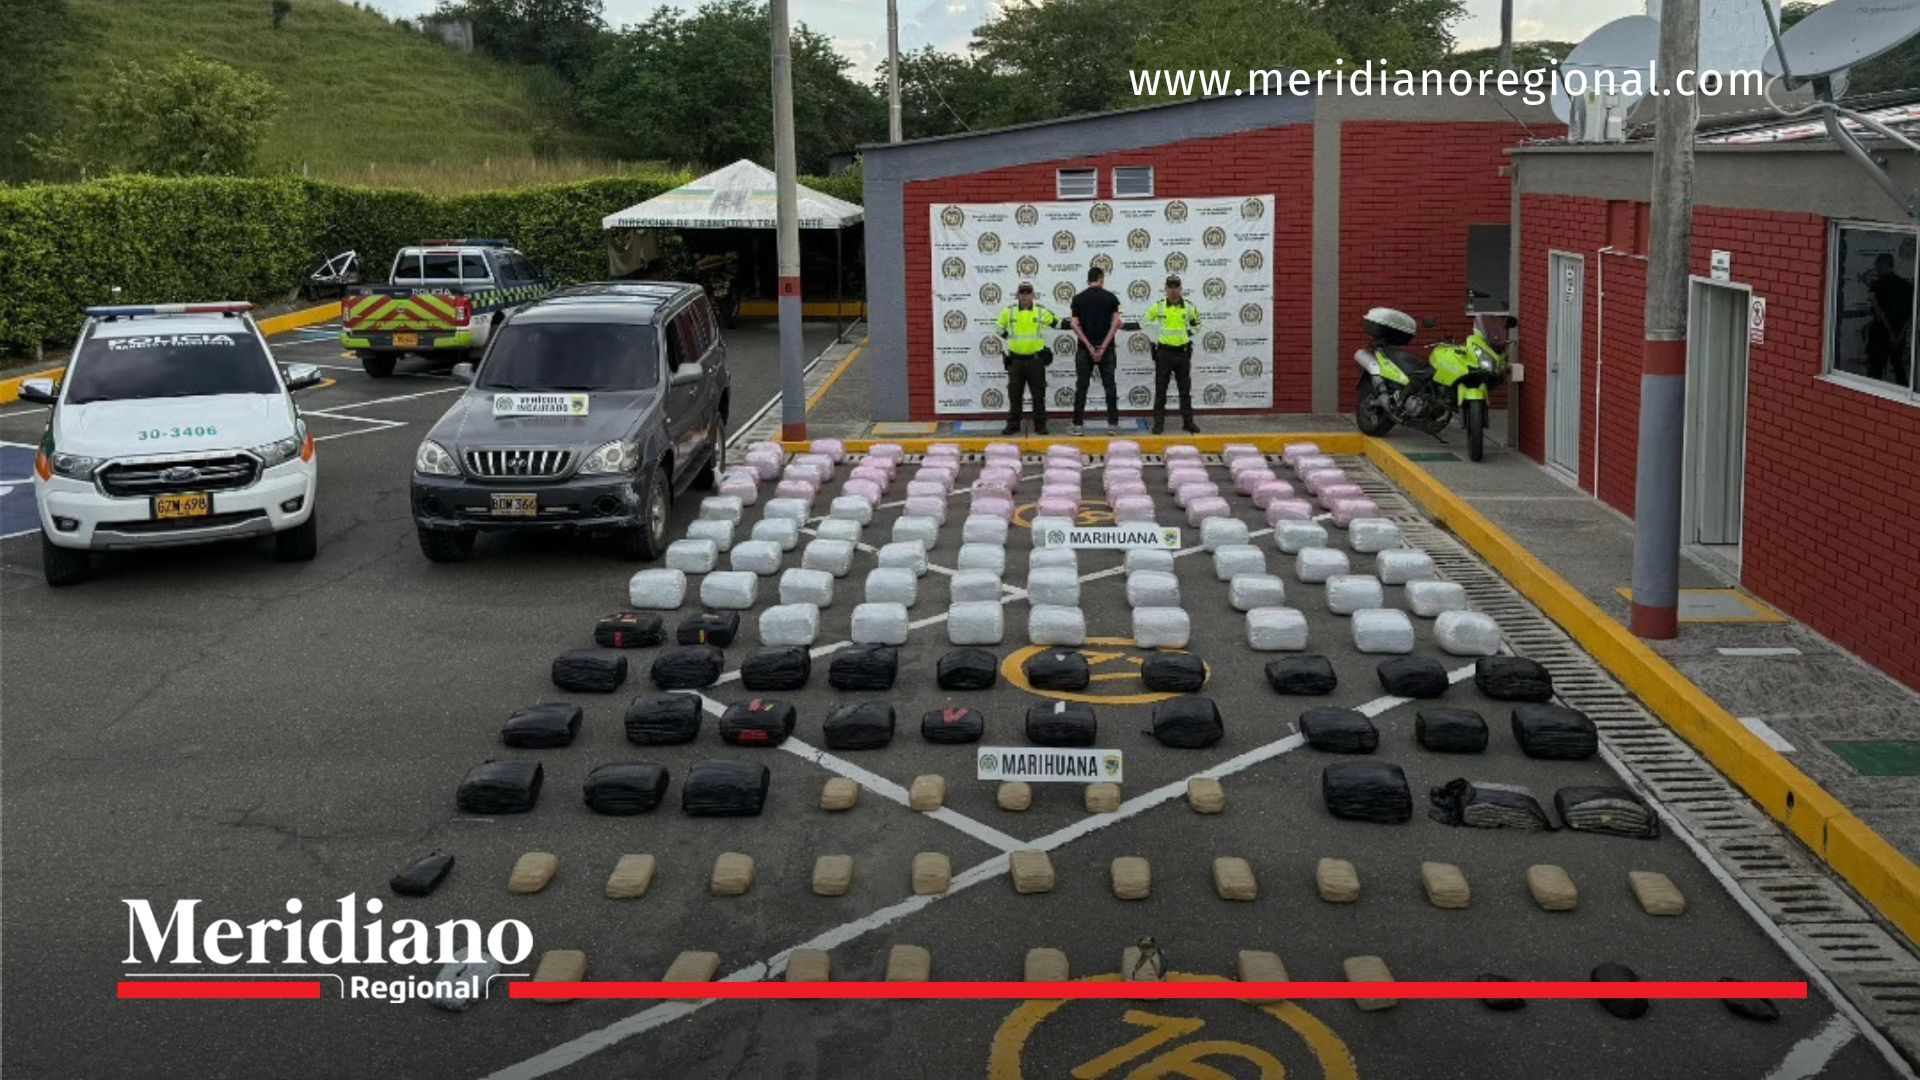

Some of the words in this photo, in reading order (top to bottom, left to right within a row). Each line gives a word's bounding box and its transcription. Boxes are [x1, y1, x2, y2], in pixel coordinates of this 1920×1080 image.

[138, 426, 218, 441] 30-3406
[1069, 530, 1158, 545] MARIHUANA
[1001, 755, 1098, 779] MARIHUANA
